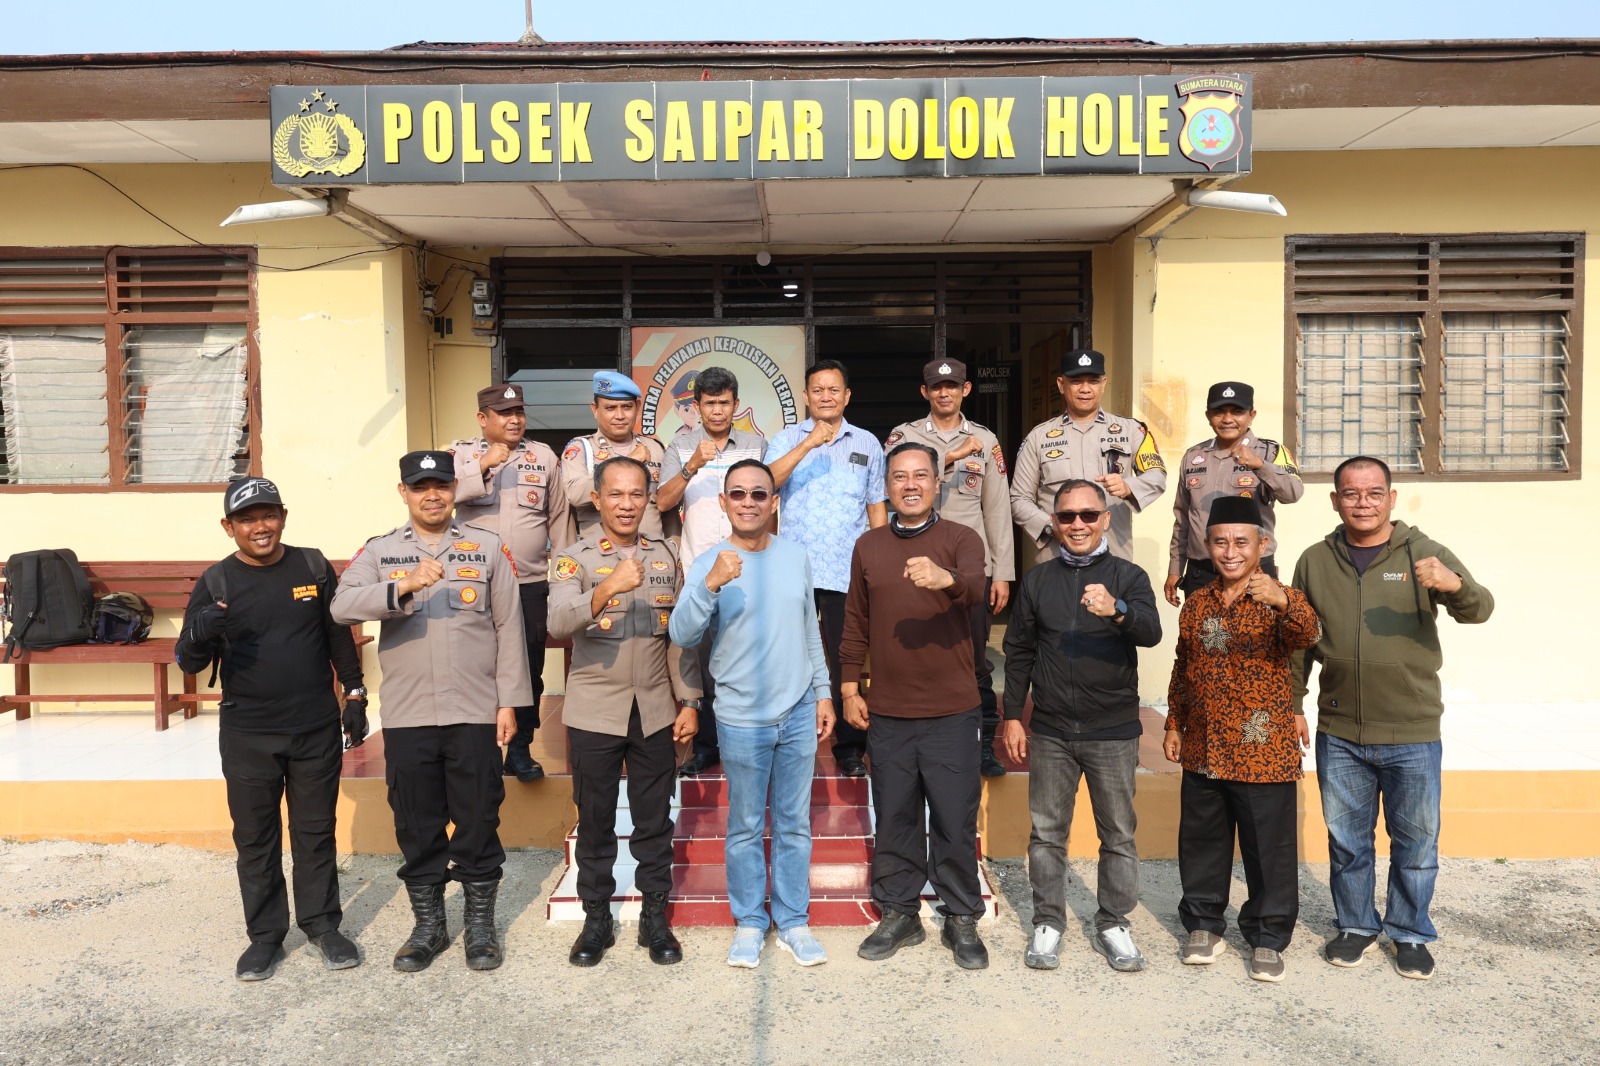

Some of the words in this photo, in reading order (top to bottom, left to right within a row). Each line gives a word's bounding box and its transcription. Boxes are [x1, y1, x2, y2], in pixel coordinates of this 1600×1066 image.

[1180, 79, 1219, 92] SUMATERA
[1220, 79, 1243, 92] UTARA
[383, 100, 594, 164] POLSEK
[624, 99, 825, 163] SAIPAR
[854, 96, 1016, 161] DOLOK
[1046, 92, 1170, 158] HOLE
[977, 367, 1011, 378] KAPOLSEK
[642, 385, 663, 435] SENTRA
[653, 337, 711, 387] PELAYANAN
[714, 336, 779, 379] KEPOLISIAN
[772, 374, 798, 429] TERPAD
[517, 464, 546, 472] POLRI
[448, 553, 486, 563] POLRI
[649, 576, 674, 585] POLRI
